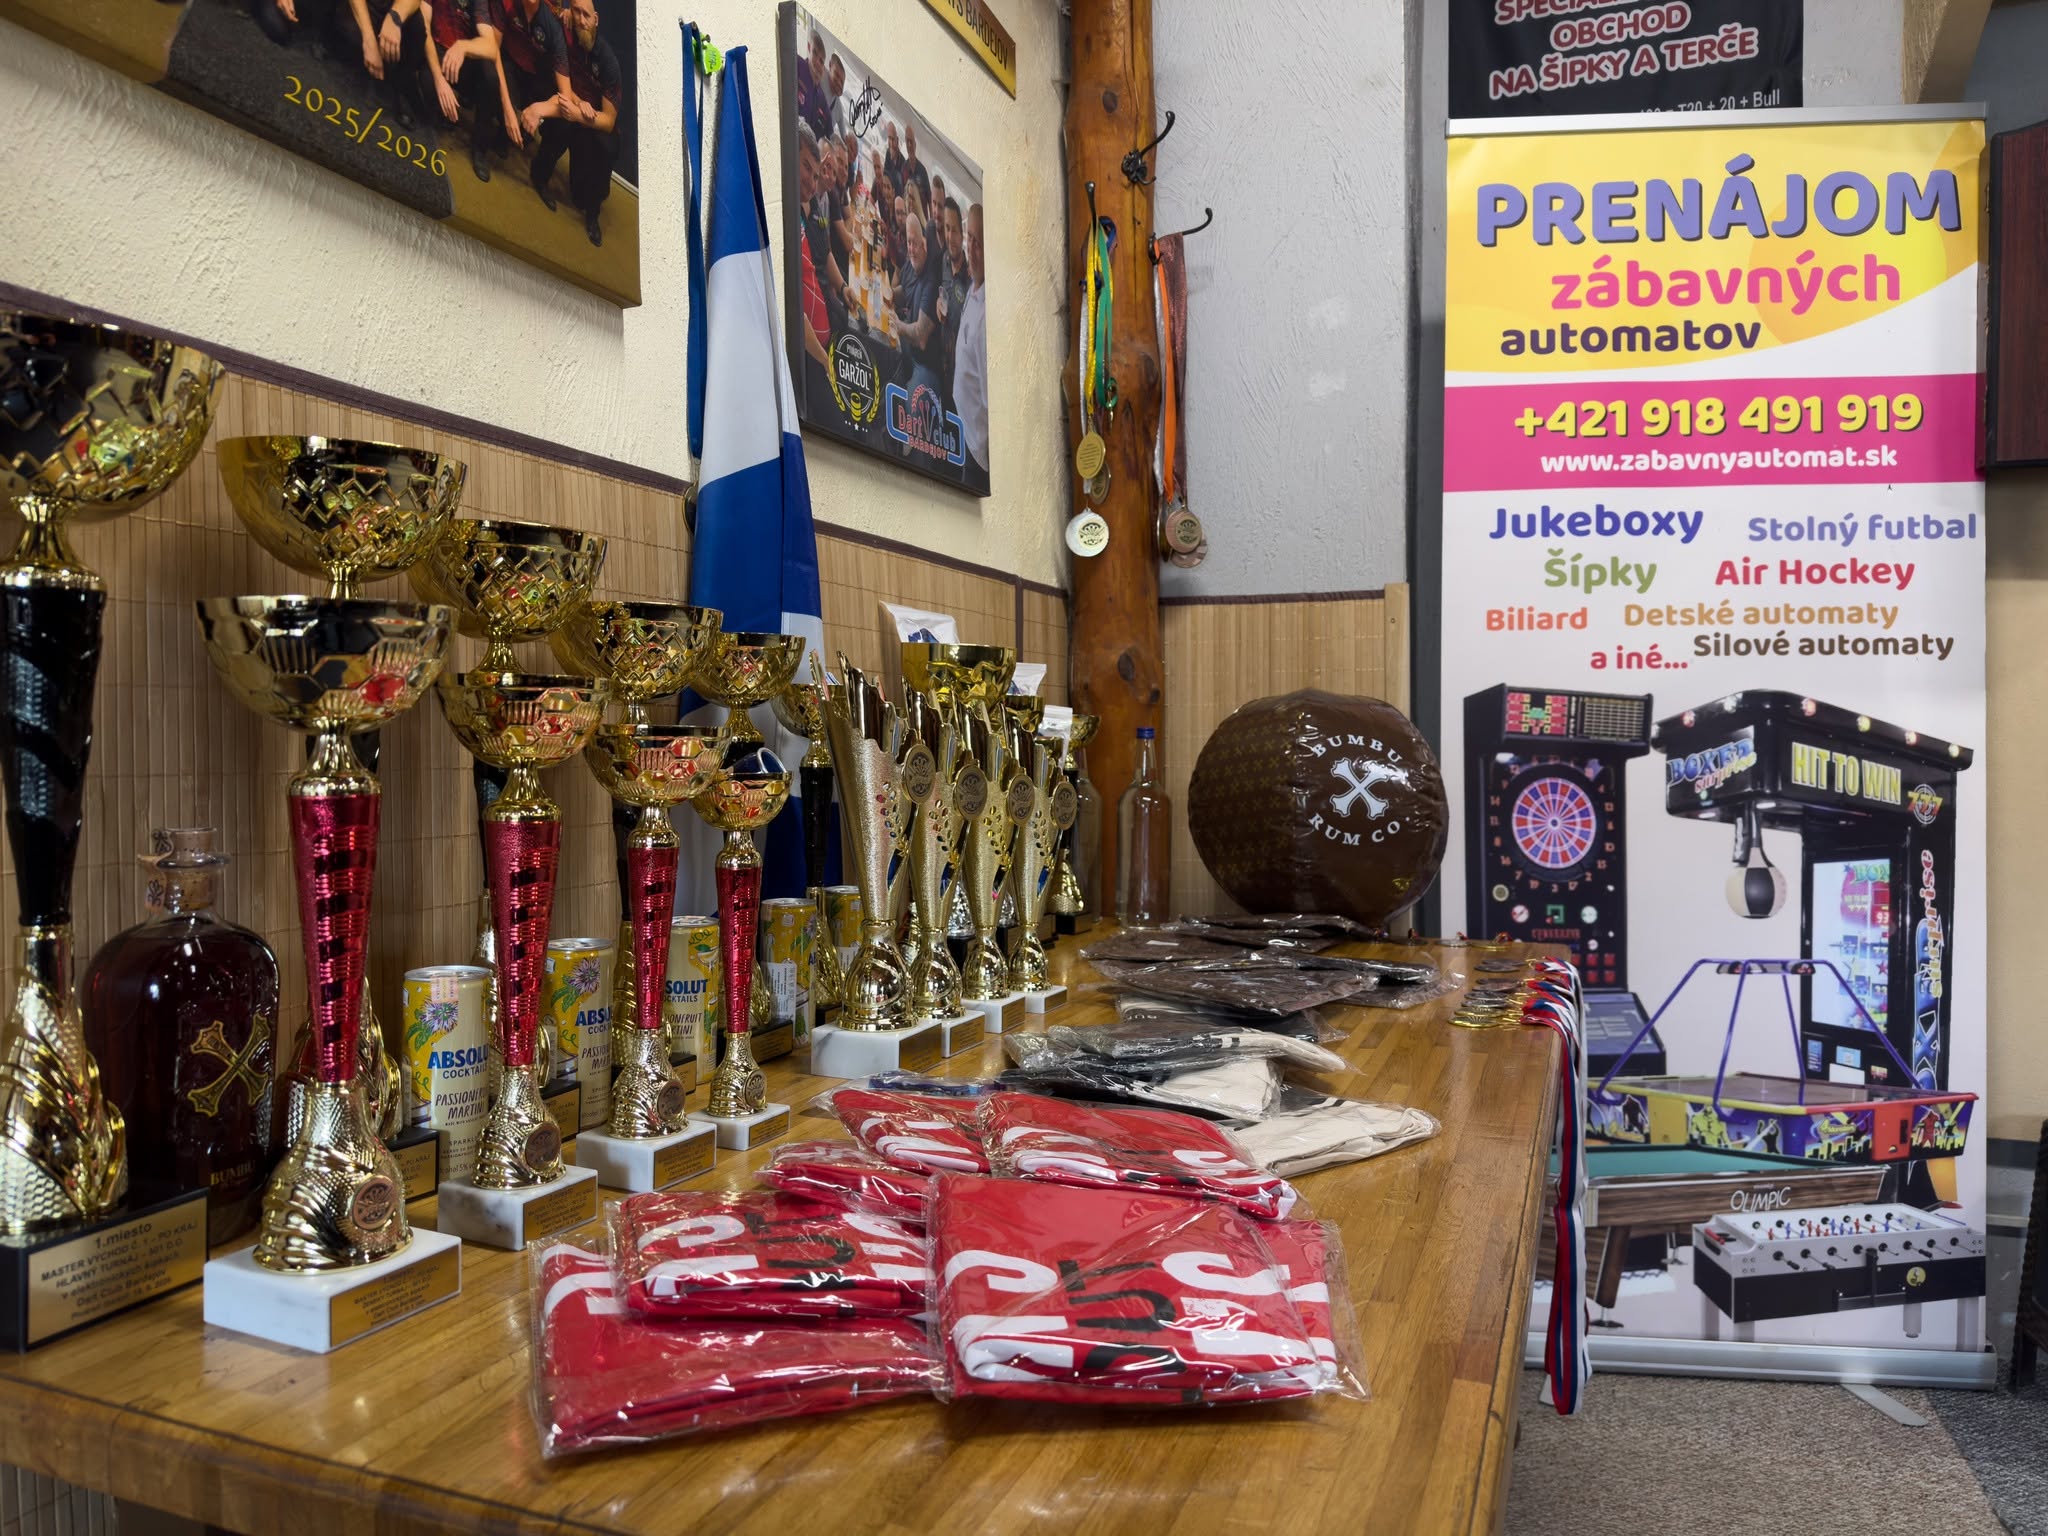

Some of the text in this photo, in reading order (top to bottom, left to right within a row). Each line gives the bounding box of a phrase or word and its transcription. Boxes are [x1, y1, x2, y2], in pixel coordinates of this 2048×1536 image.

[966, 0, 1008, 70] BARDEJOV
[1550, 1, 1691, 51] OBCHOD
[1489, 22, 1760, 100] NA ŠIPKY A TERČE
[1720, 96, 1736, 111] 20
[1753, 88, 1781, 108] Bull
[283, 75, 447, 177] 2025/2026
[1476, 153, 1962, 247] PRENÁJOM
[1550, 250, 1900, 315] zábavných
[1500, 320, 1762, 356] automatov
[898, 404, 956, 453] Dart club
[1514, 392, 1925, 438] +421 918 491 919
[1540, 445, 1898, 474] www.zabavnyautomat.sk
[1489, 505, 1704, 544] Jukeboxy
[1747, 513, 1977, 547] Stolný futbal
[1543, 548, 1658, 594] Šípky
[1714, 557, 1916, 590] Air Hockey
[1486, 607, 1589, 632] Biliard
[1623, 599, 1899, 630] Detské automaty
[1589, 644, 1689, 670] a iné...
[1693, 630, 1955, 661] Silové automaty
[1311, 734, 1403, 762] BUMBU
[1791, 741, 1902, 805] HIT TO WIN
[1308, 813, 1361, 846] RUM
[665, 979, 708, 995] SOLUT
[575, 1007, 611, 1027] ABSO
[427, 1043, 489, 1069] ABSOLU
[1730, 1186, 1792, 1213] OLIMPIC
[41, 1259, 85, 1281] MASTER
